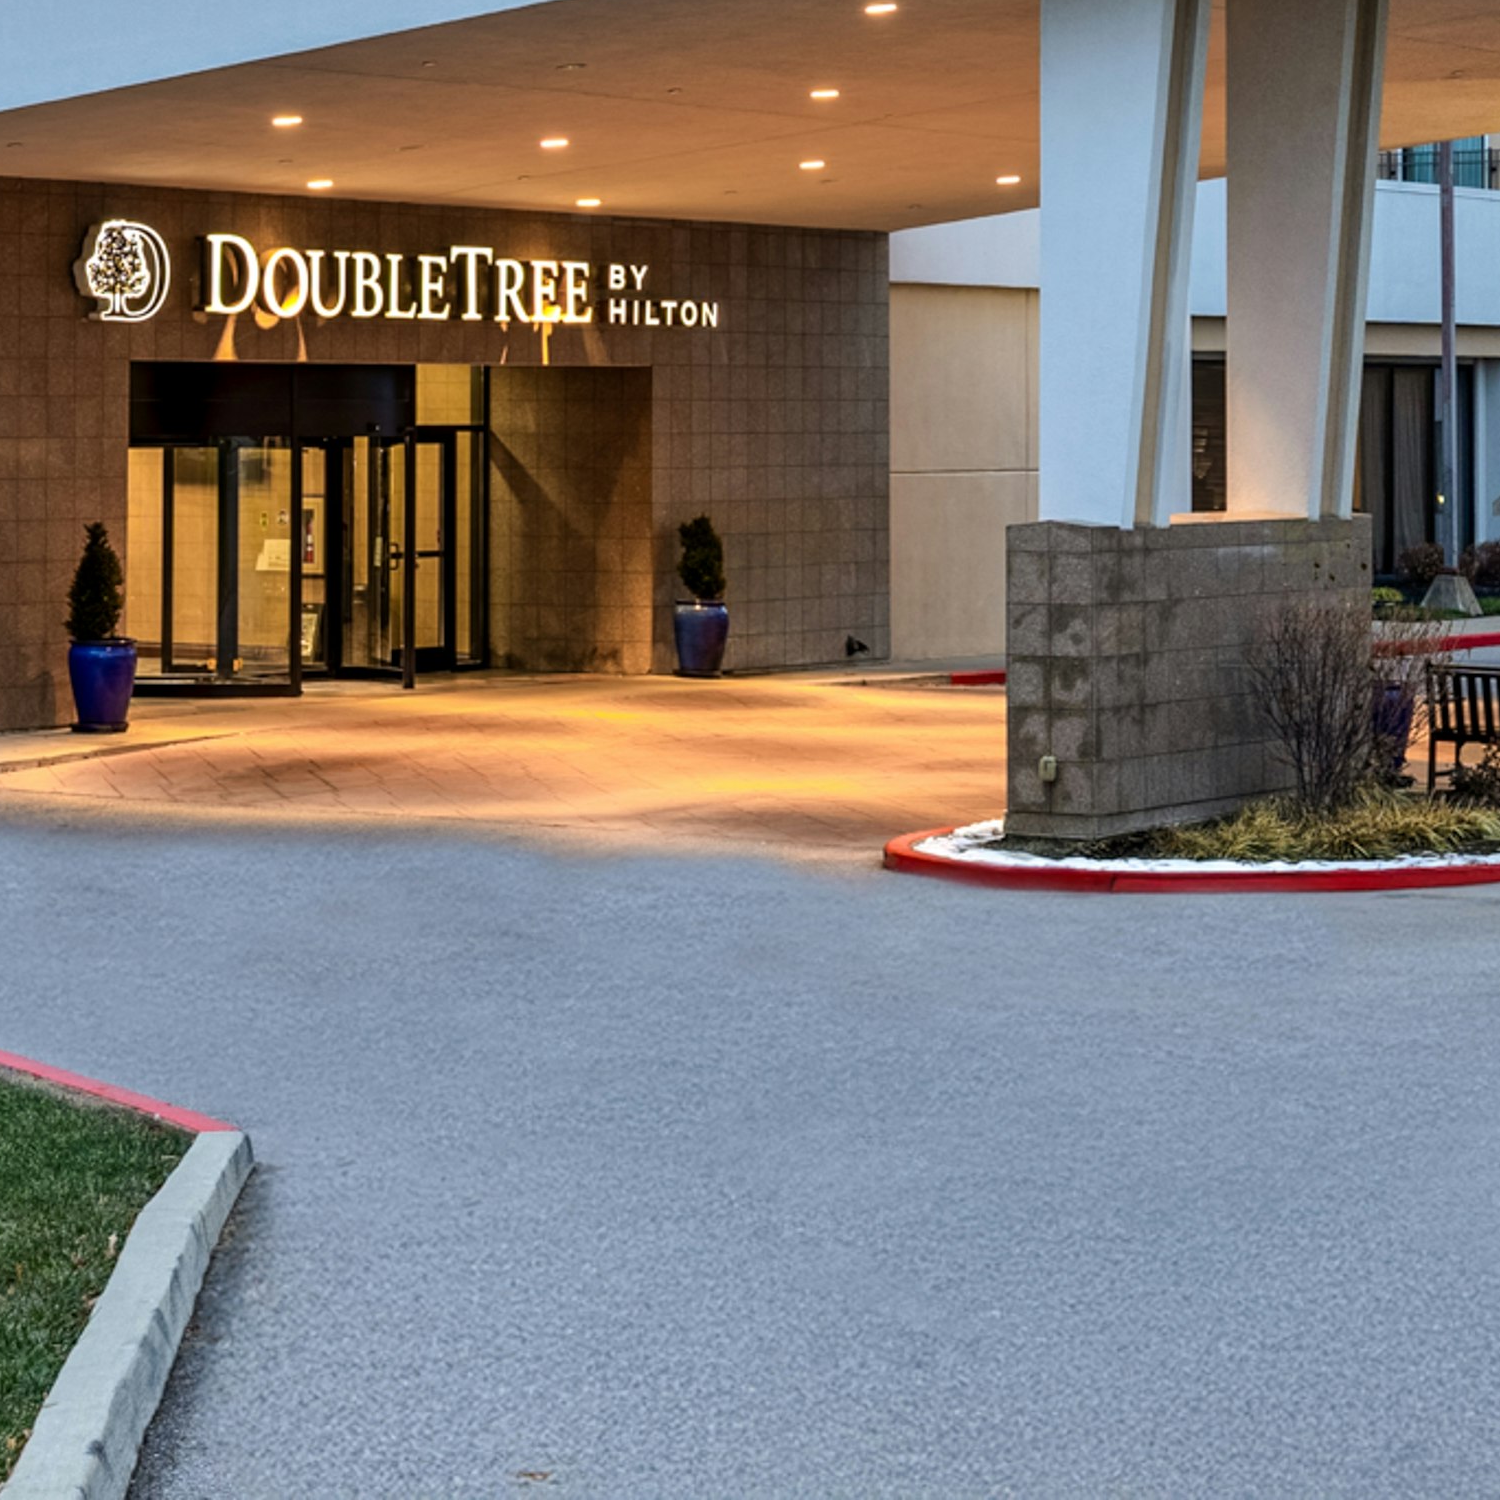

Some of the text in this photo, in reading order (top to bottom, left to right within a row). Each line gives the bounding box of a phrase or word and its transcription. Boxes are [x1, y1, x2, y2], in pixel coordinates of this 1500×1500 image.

[204, 233, 593, 324] DOUBLETREE
[609, 263, 649, 291] BY
[608, 298, 719, 328] HILTON
